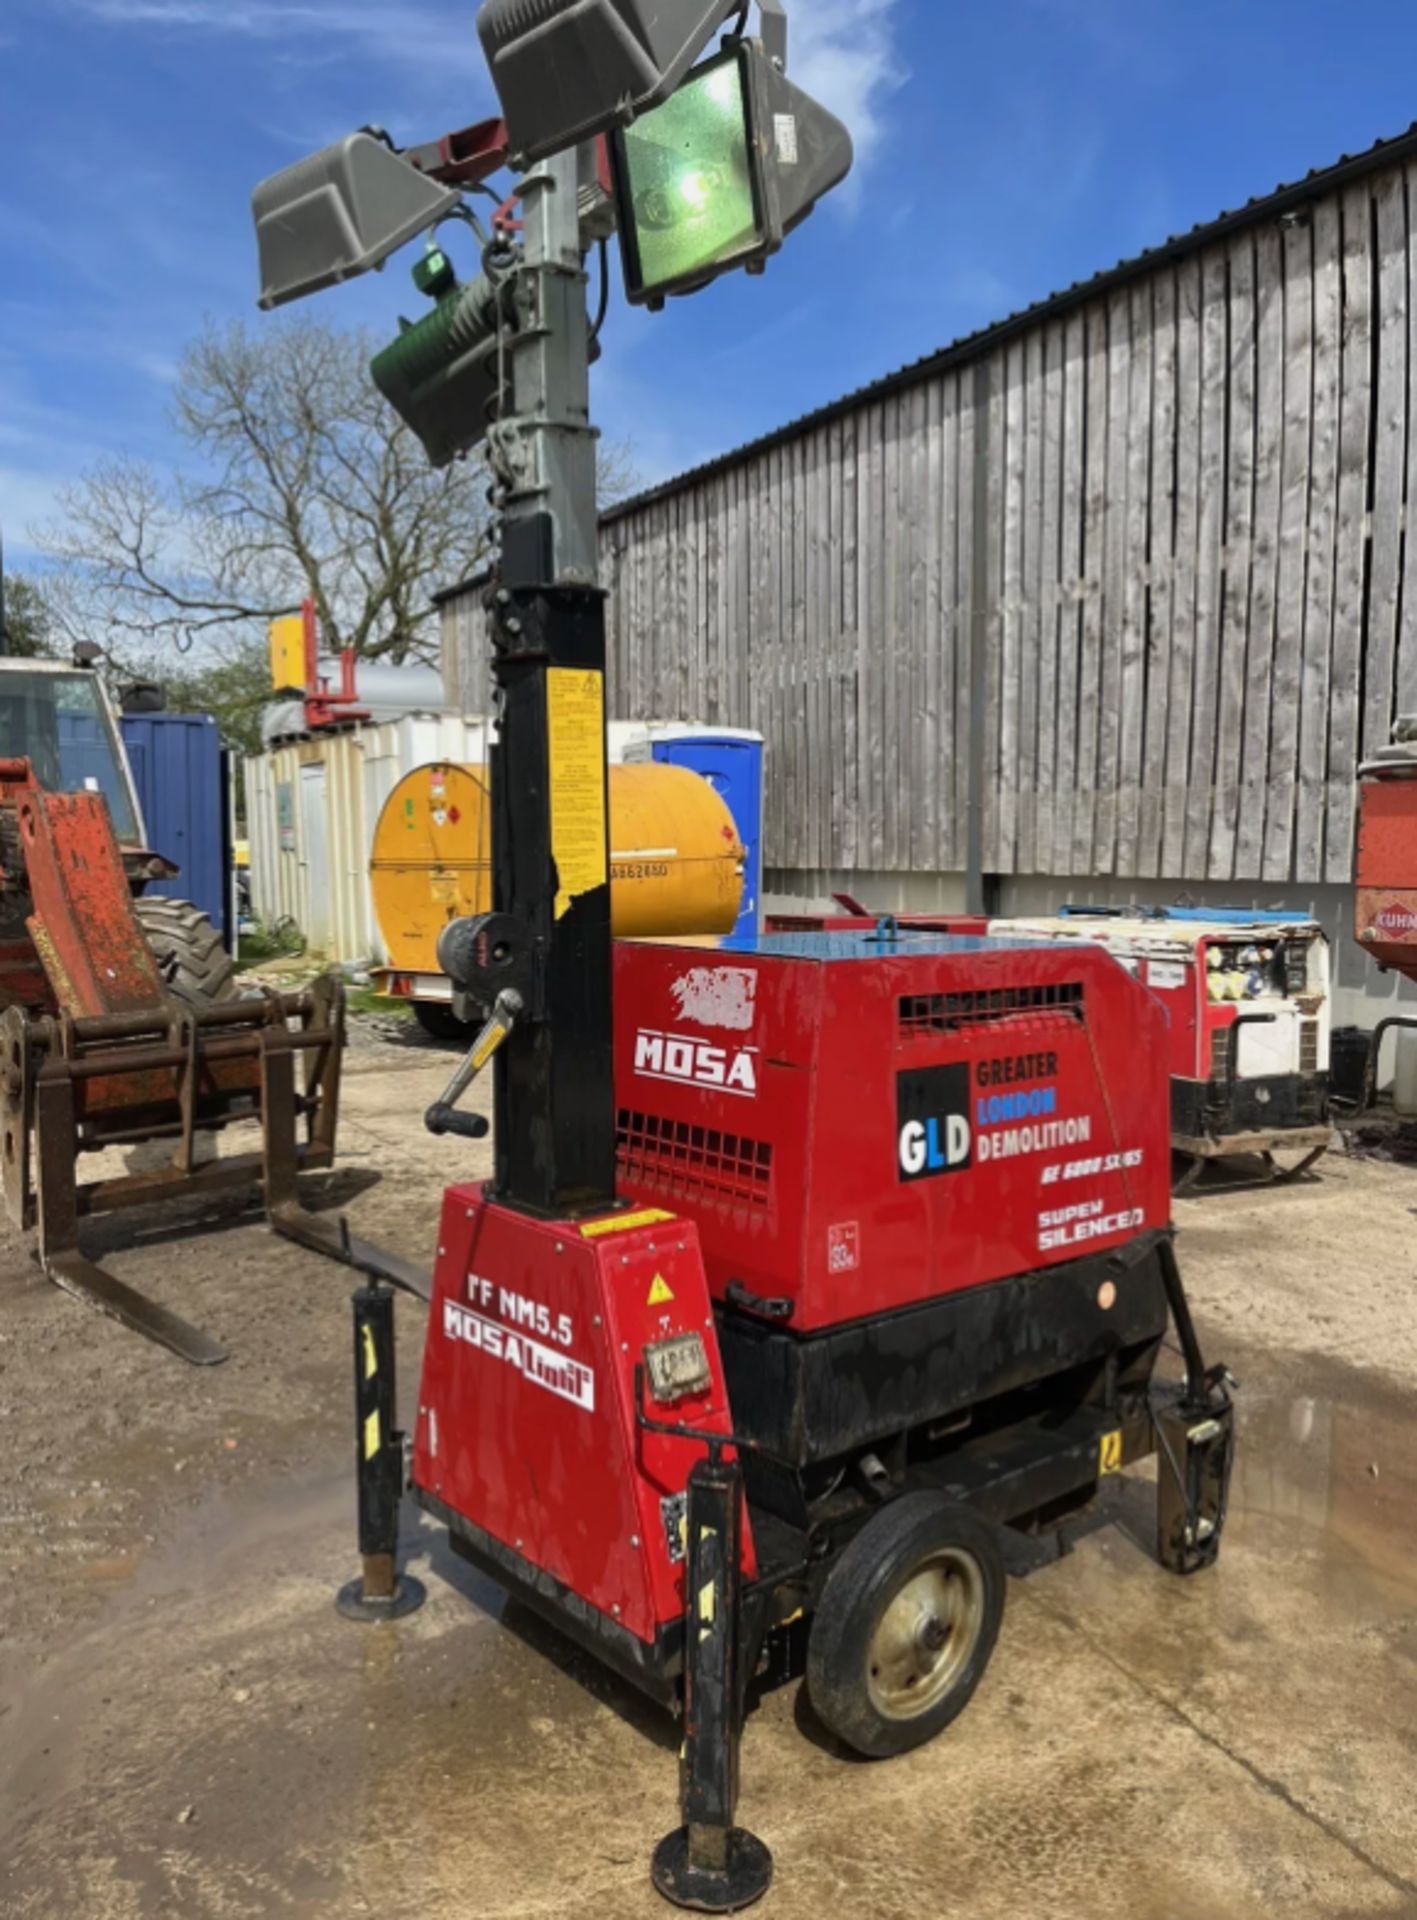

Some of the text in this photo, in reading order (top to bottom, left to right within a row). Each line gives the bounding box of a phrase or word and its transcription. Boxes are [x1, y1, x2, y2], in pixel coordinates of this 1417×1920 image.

[634, 1034, 757, 1090] MOSA
[976, 1052, 1058, 1087] GREATER
[977, 1087, 1056, 1126] LONDON
[899, 1114, 971, 1174] GLD
[977, 1116, 1091, 1162] DEMOLITION
[1038, 1208, 1144, 1251] SILENCED
[444, 1303, 523, 1370] MOSA
